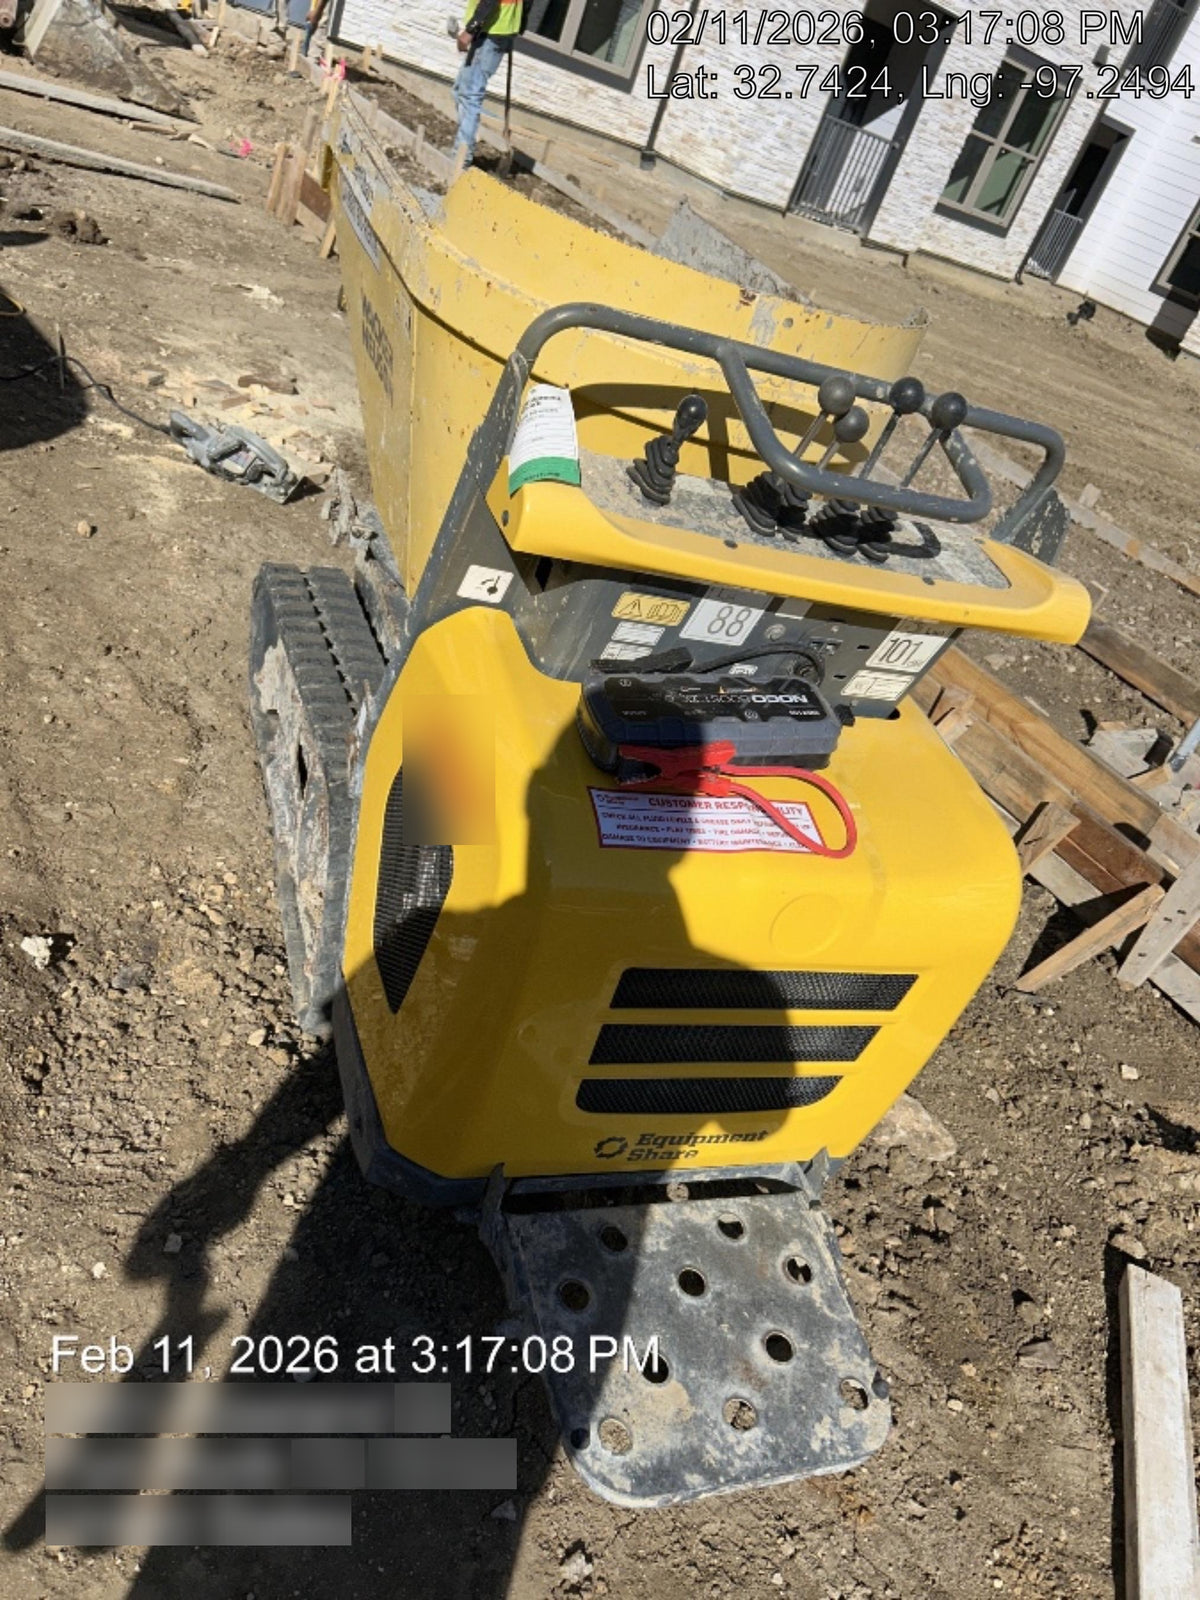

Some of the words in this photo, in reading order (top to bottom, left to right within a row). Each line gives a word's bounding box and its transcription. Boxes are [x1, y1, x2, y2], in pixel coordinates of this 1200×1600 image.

[707, 605, 752, 637] 88
[878, 637, 924, 665] 101
[751, 694, 808, 703] NOCO
[648, 797, 713, 810] CUSTOMER
[636, 1129, 769, 1148] Equipment
[627, 1149, 699, 1161] Share
